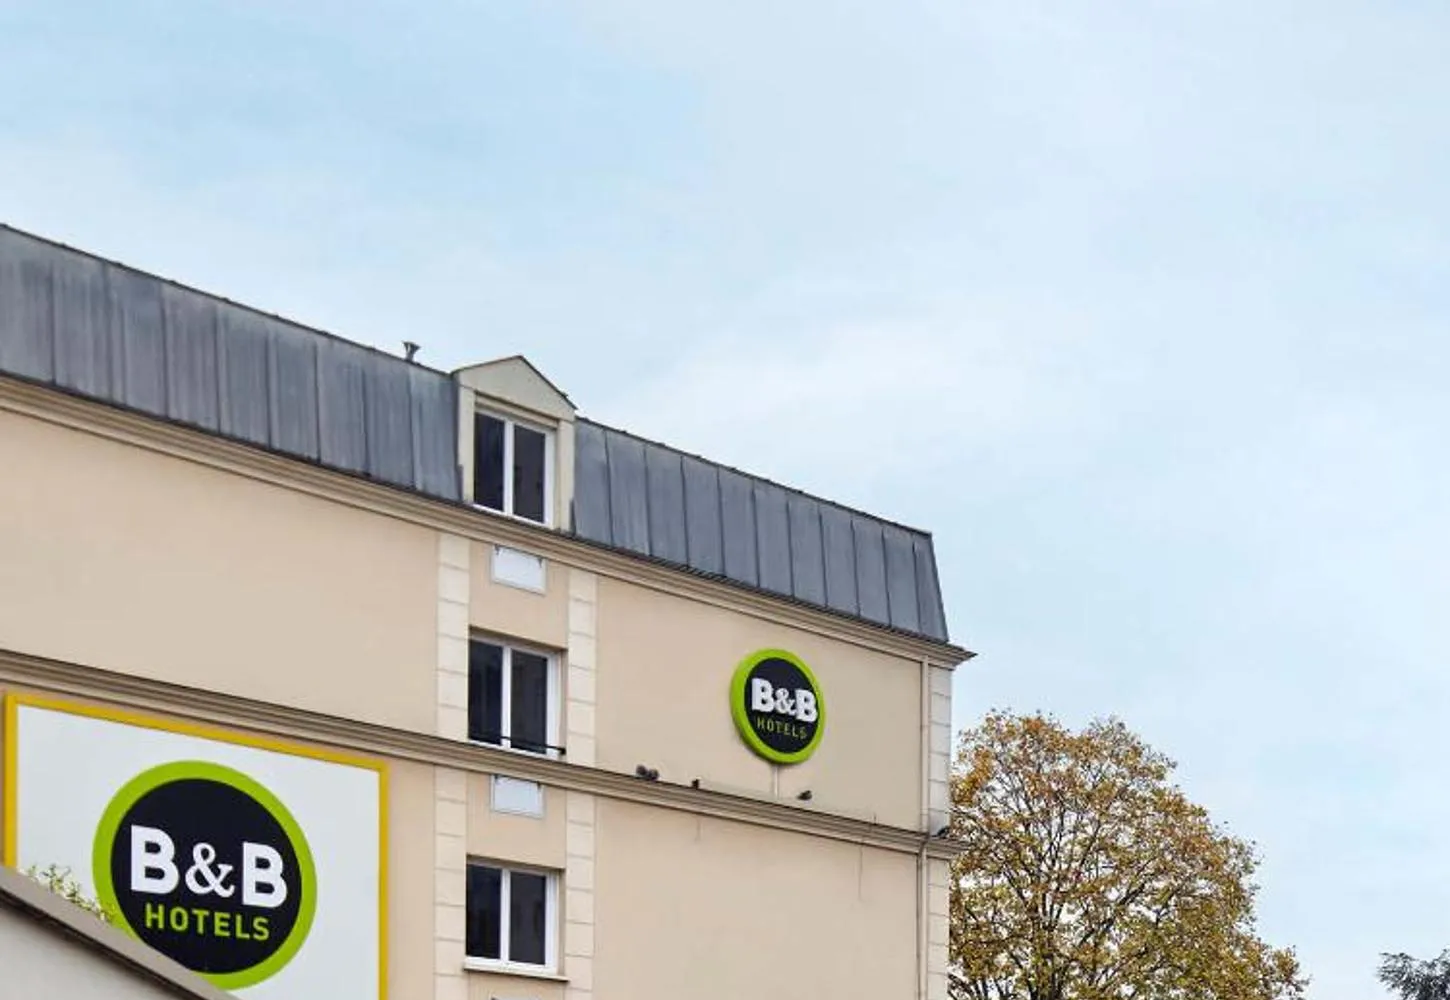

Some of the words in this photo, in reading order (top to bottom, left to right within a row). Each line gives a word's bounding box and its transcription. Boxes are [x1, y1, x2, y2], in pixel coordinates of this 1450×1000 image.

[752, 677, 817, 722] B&B
[757, 717, 807, 739] HOTELS
[131, 825, 287, 908] B&B
[145, 903, 270, 941] HOTELS
